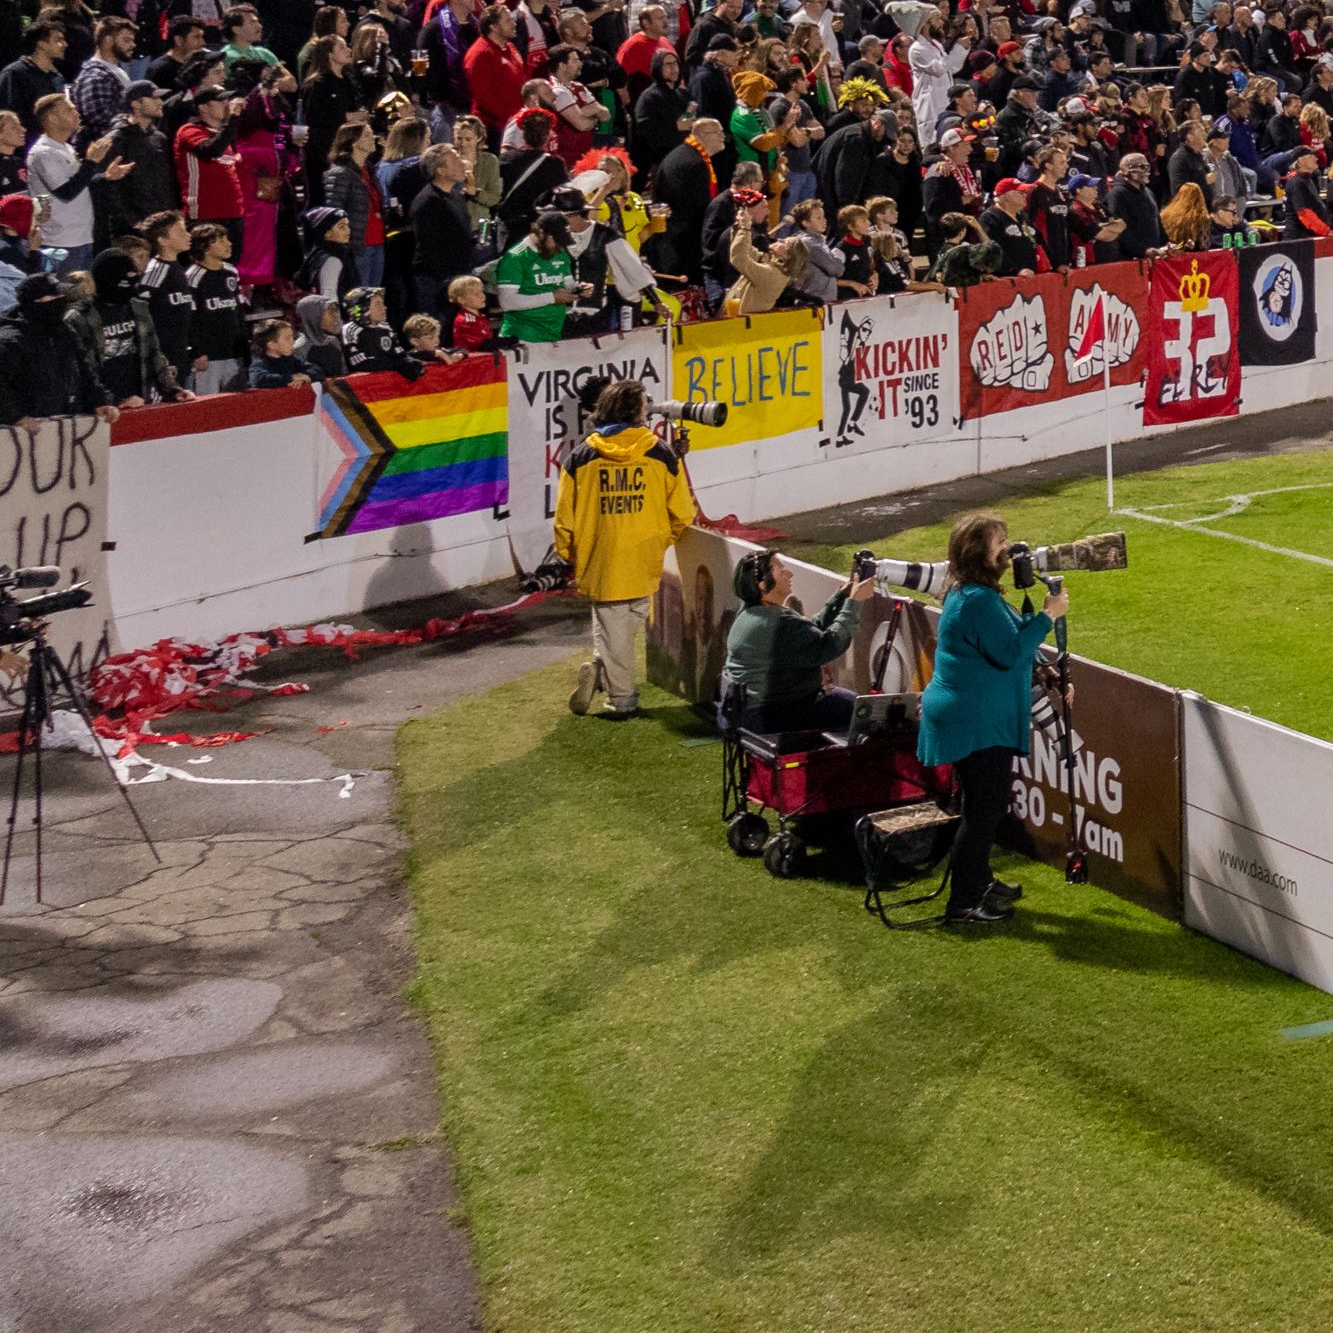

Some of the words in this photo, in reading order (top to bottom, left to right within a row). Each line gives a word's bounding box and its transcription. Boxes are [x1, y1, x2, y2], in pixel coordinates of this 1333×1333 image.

[977, 321, 1024, 374] RED
[1073, 304, 1136, 344] AMY
[684, 341, 811, 406] BELIEVE
[854, 333, 948, 382] KICKIN'
[1164, 297, 1231, 404] 32
[878, 378, 903, 420] IT
[904, 373, 939, 393] SINCE
[904, 394, 939, 429] '93
[545, 404, 568, 441] IS
[599, 467, 646, 492] R.M.C.
[600, 495, 645, 514] EVENTS
[1217, 847, 1299, 897] www.daa.com
